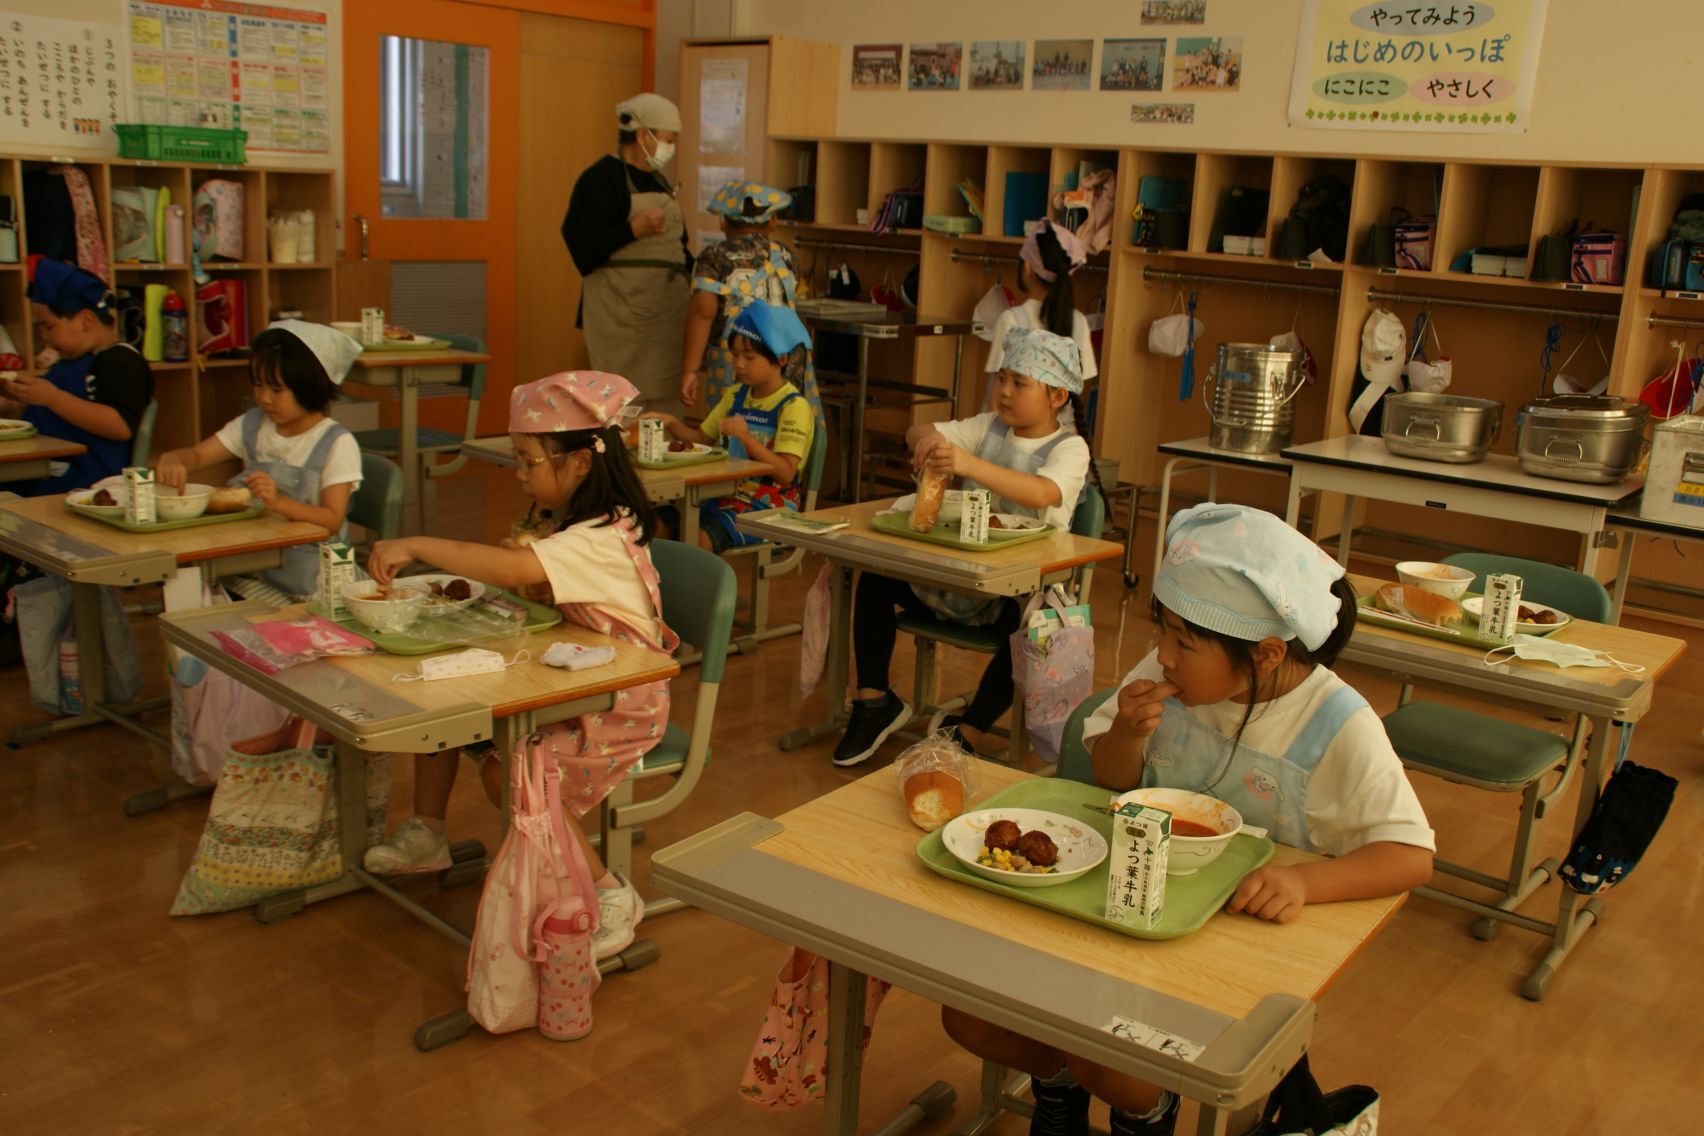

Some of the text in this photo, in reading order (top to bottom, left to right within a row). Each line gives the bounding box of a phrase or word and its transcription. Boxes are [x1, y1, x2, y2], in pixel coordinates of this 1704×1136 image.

[1370, 5, 1476, 27] やってみよう
[1326, 34, 1512, 64] はじめのいっぽ
[1324, 79, 1390, 96] にこにこ
[1427, 79, 1494, 98] やさしく
[1122, 840, 1140, 908] よつ葉牛乳
